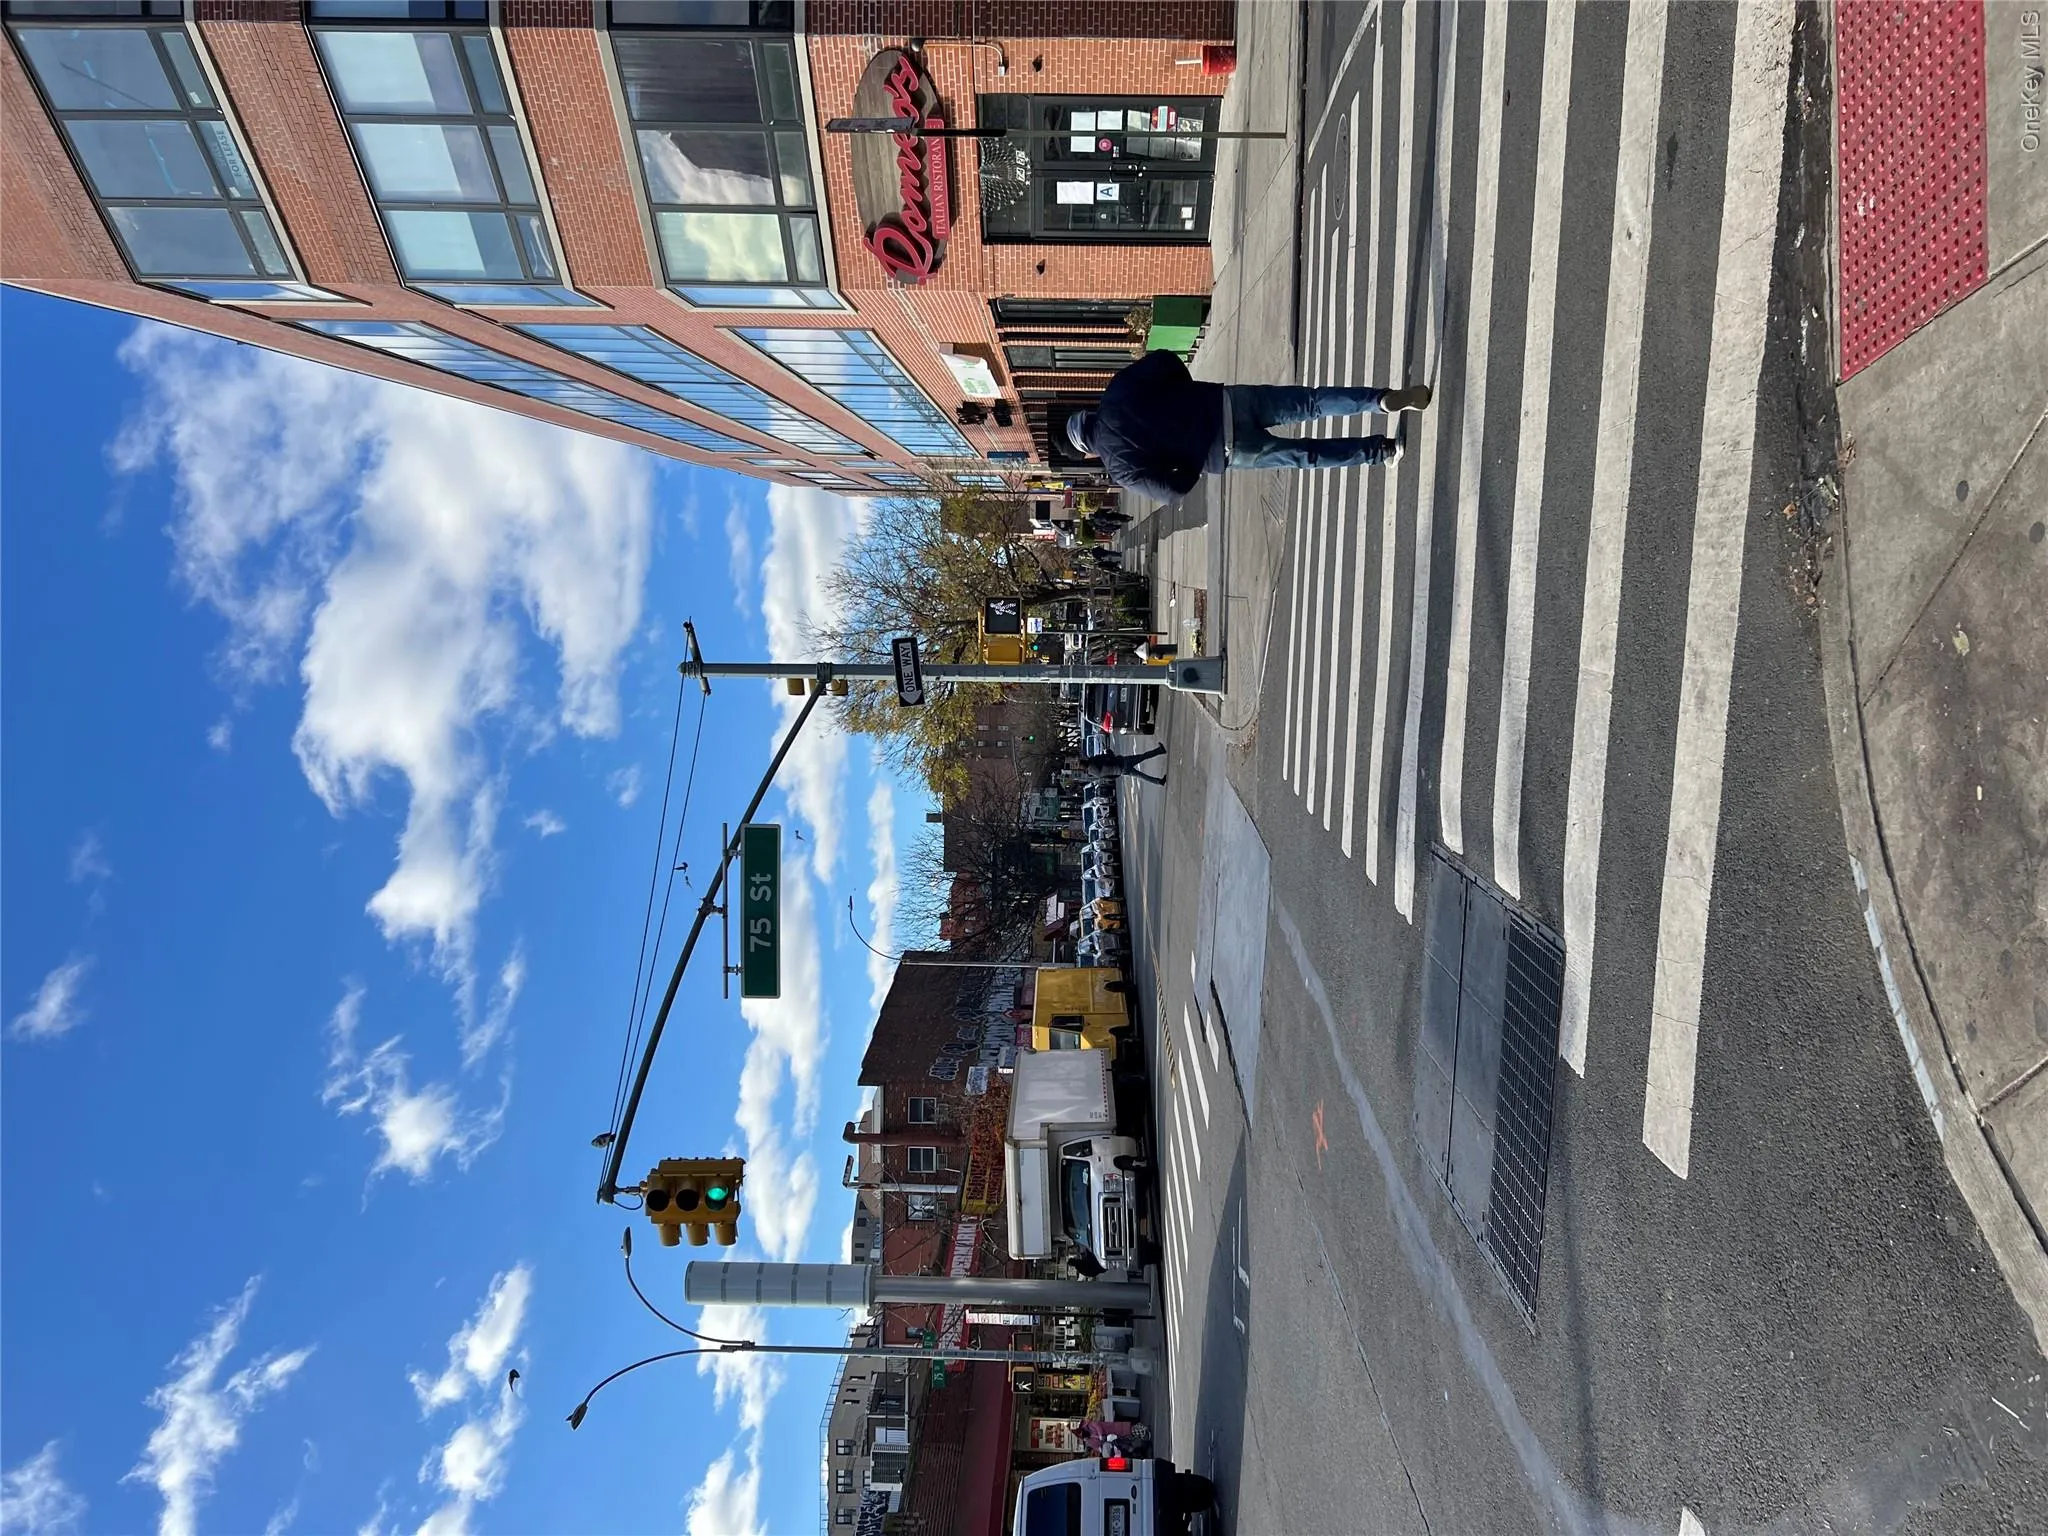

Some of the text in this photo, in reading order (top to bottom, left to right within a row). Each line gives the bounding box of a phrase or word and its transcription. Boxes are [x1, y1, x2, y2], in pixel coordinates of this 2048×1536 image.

[216, 130, 242, 176] FOR LEASE
[863, 55, 937, 285] Romeo's
[930, 124, 946, 234] ITALIAN RISTORANE
[1100, 187, 1112, 197] A
[901, 646, 915, 692] ONE WAY
[750, 873, 772, 952] 75 St
